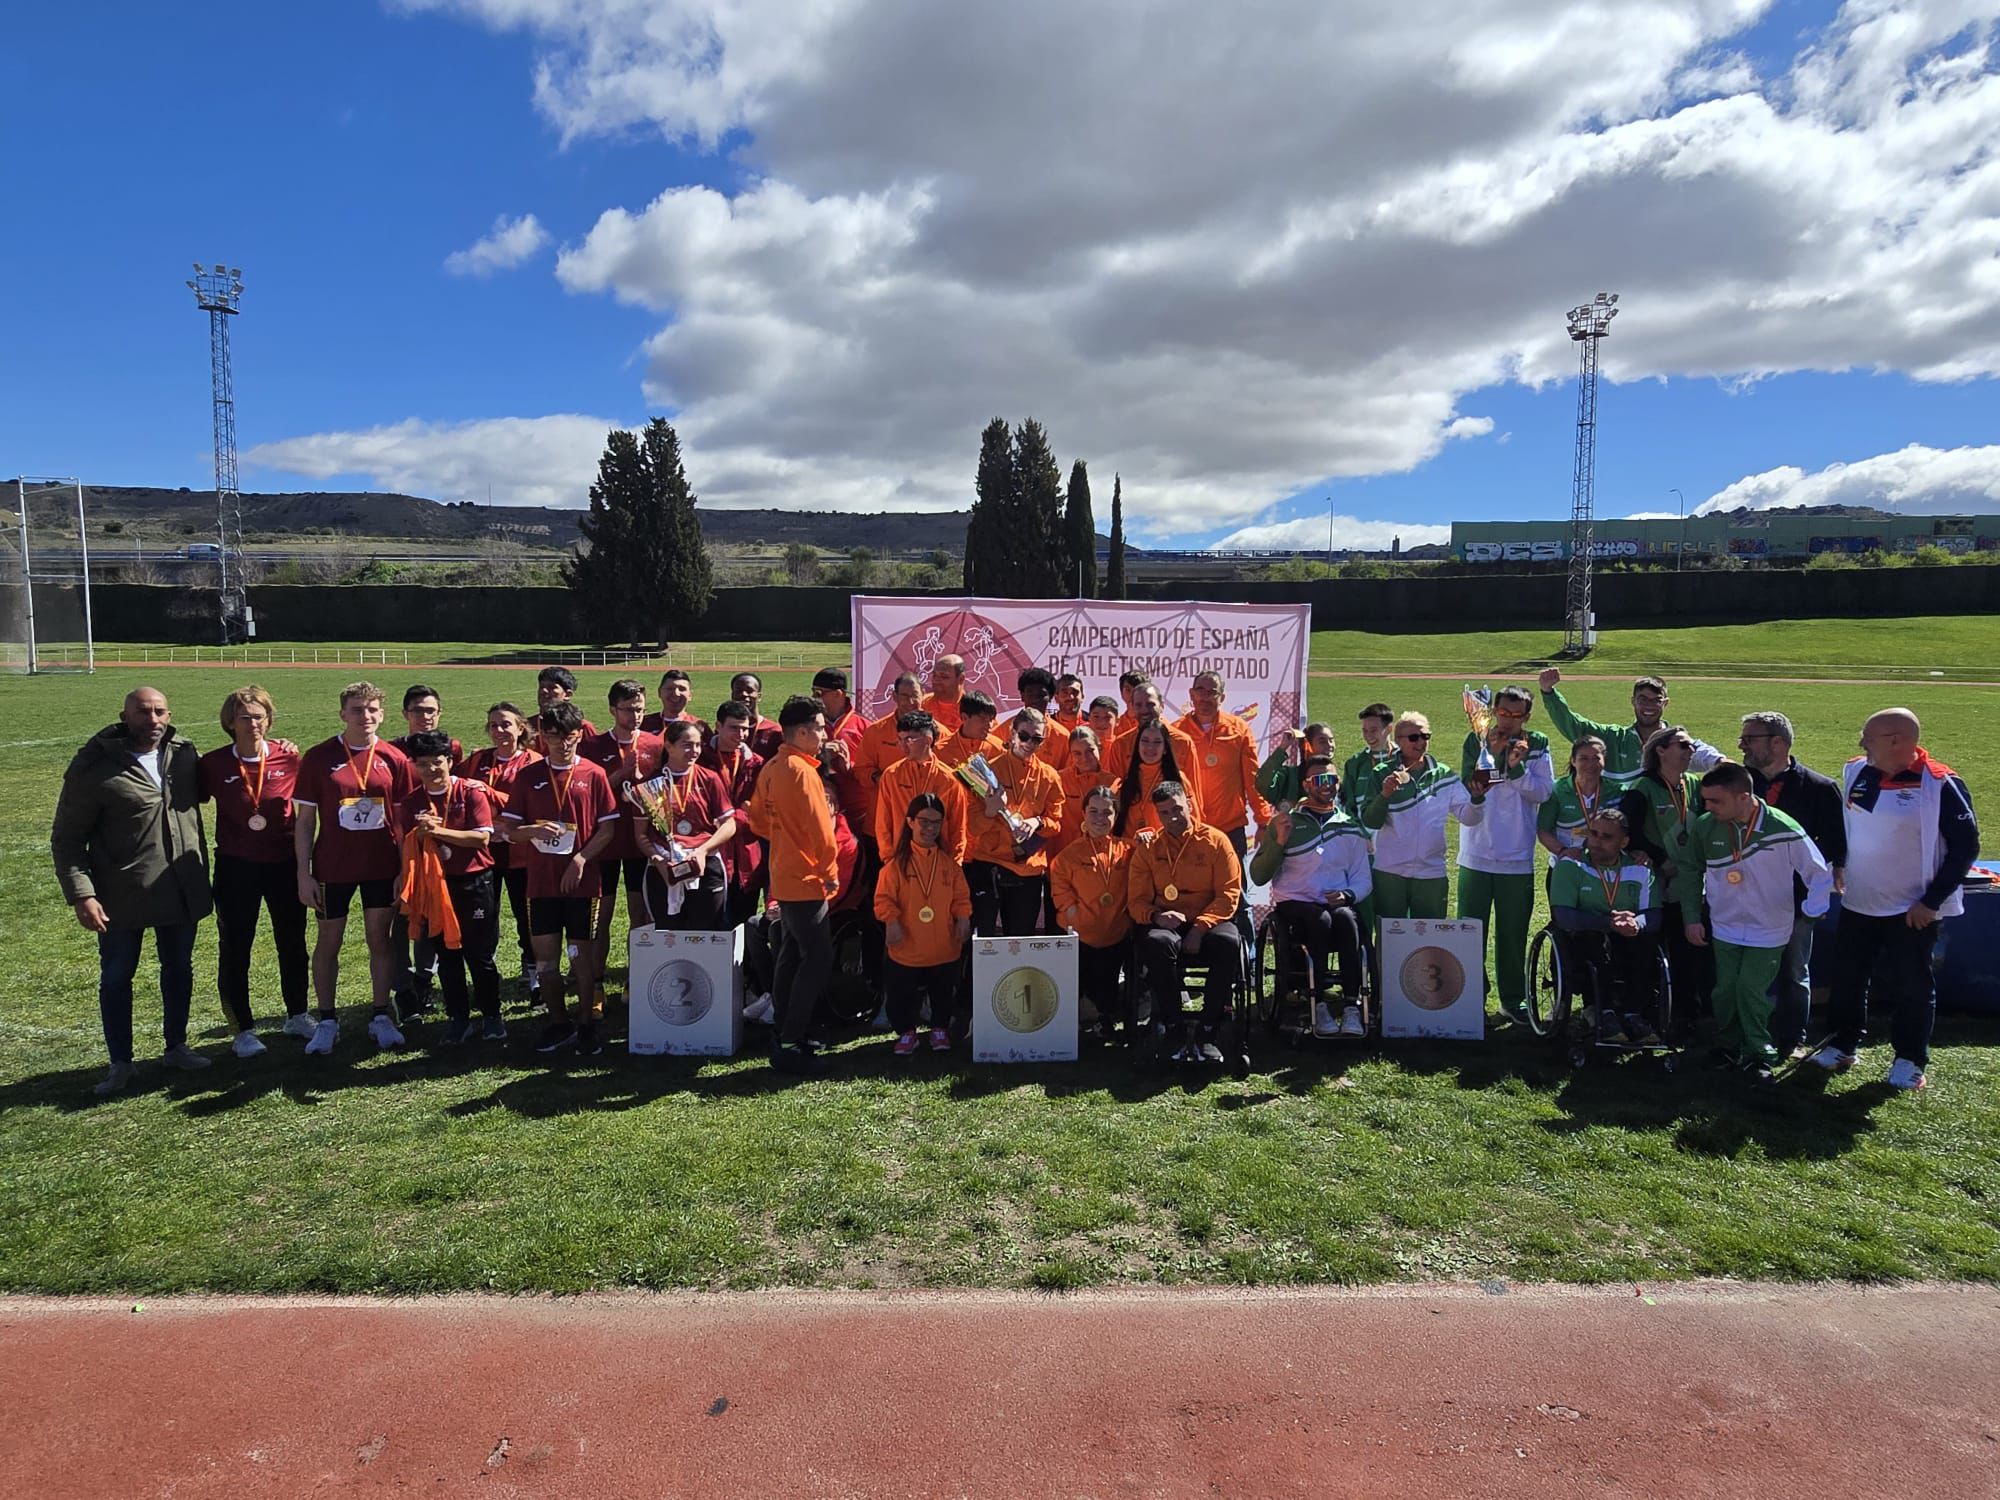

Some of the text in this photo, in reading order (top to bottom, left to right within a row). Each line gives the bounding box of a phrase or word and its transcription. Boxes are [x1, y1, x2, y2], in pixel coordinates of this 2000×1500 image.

[1049, 625, 1270, 650] CAMPEONATO DE ESPAÑA
[1049, 655, 1270, 679] DE ATLETISMO ADAPTADO
[353, 812, 370, 824] 47
[1422, 964, 1442, 992] 3
[669, 977, 693, 1008] 2
[1014, 984, 1031, 1014] 1
